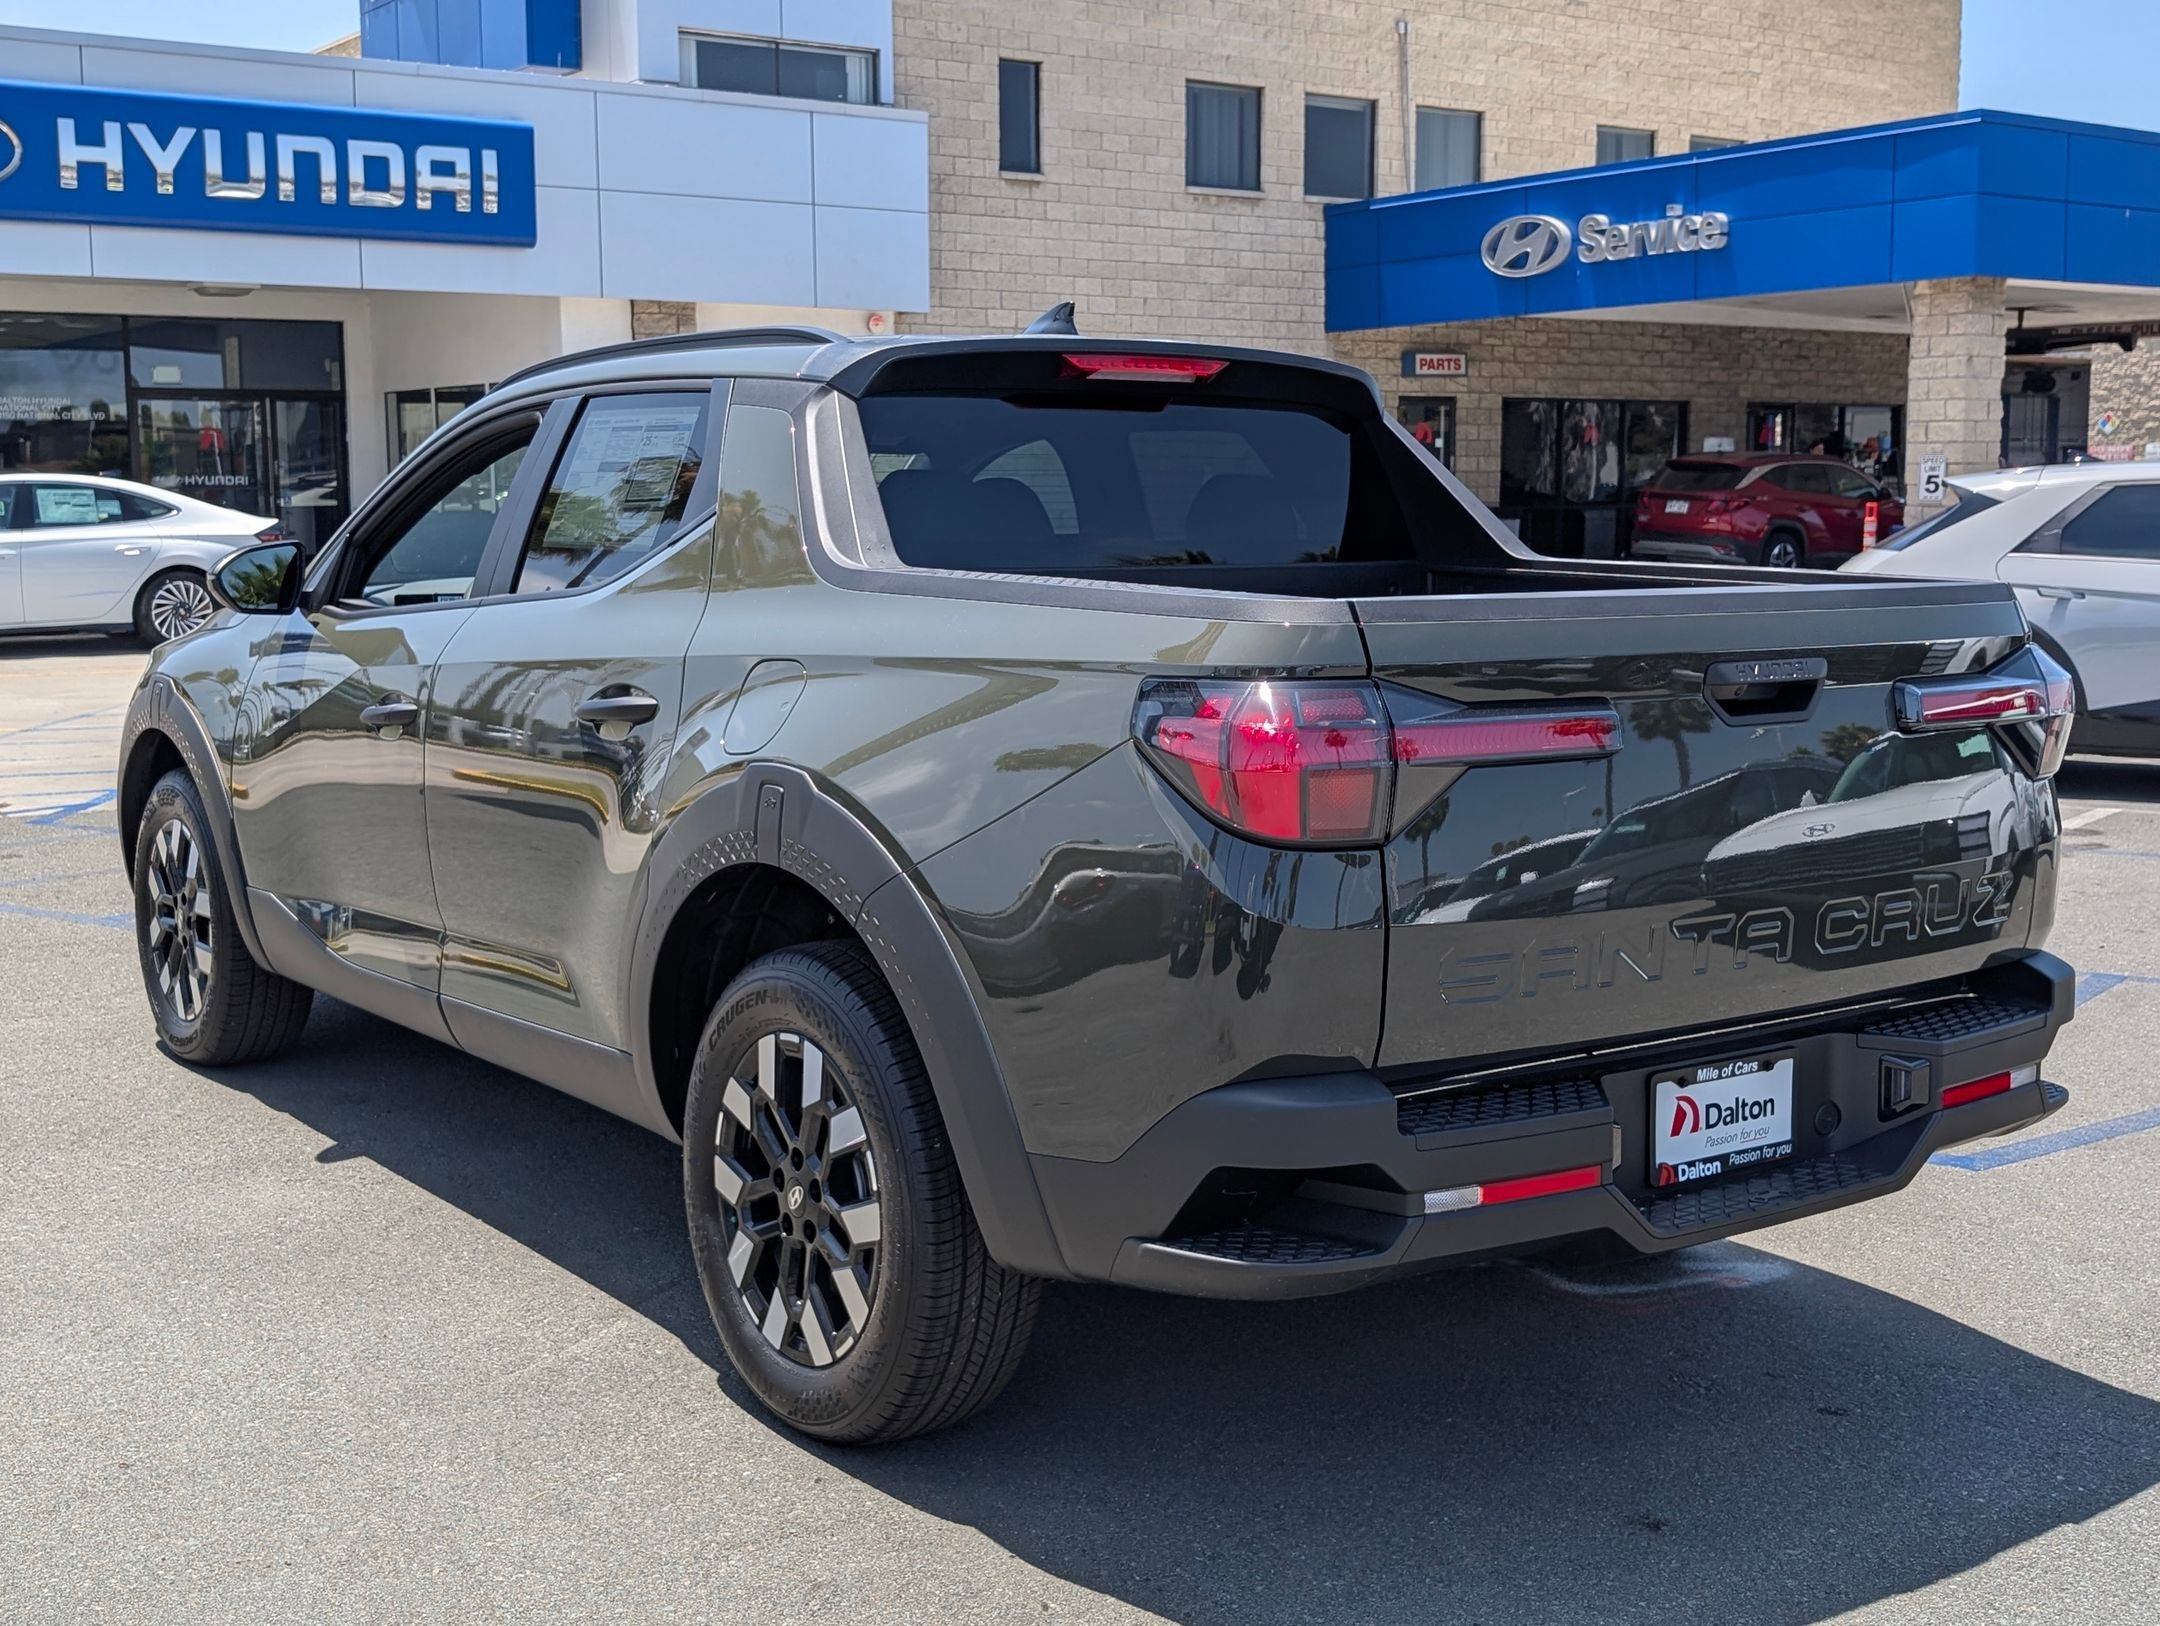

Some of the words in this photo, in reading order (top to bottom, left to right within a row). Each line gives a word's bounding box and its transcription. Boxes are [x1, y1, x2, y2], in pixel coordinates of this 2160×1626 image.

[57, 118, 498, 214] HYUNDAI
[1577, 204, 1728, 263] Service
[1419, 358, 1461, 371] PARTS
[185, 475, 249, 486] HYUNDAI
[1924, 474, 1940, 494] 5
[1736, 660, 1813, 682] HYUNDAI
[1438, 905, 1796, 1006] SANTA
[1814, 869, 2014, 956] CRUZ
[709, 988, 768, 1051] CRUGEN
[1696, 1068, 1719, 1082] Mile
[1721, 1063, 1734, 1078] of
[1734, 1060, 1759, 1075] Cars
[1705, 1096, 1775, 1130] Dalton
[1704, 1132, 1738, 1149] Passion
[1740, 1127, 1752, 1142] for
[1753, 1126, 1771, 1141] you
[1678, 1159, 1721, 1182] Dalton
[1728, 1149, 1761, 1166] Passion
[1762, 1144, 1775, 1159] for
[1775, 1143, 1792, 1158] you
